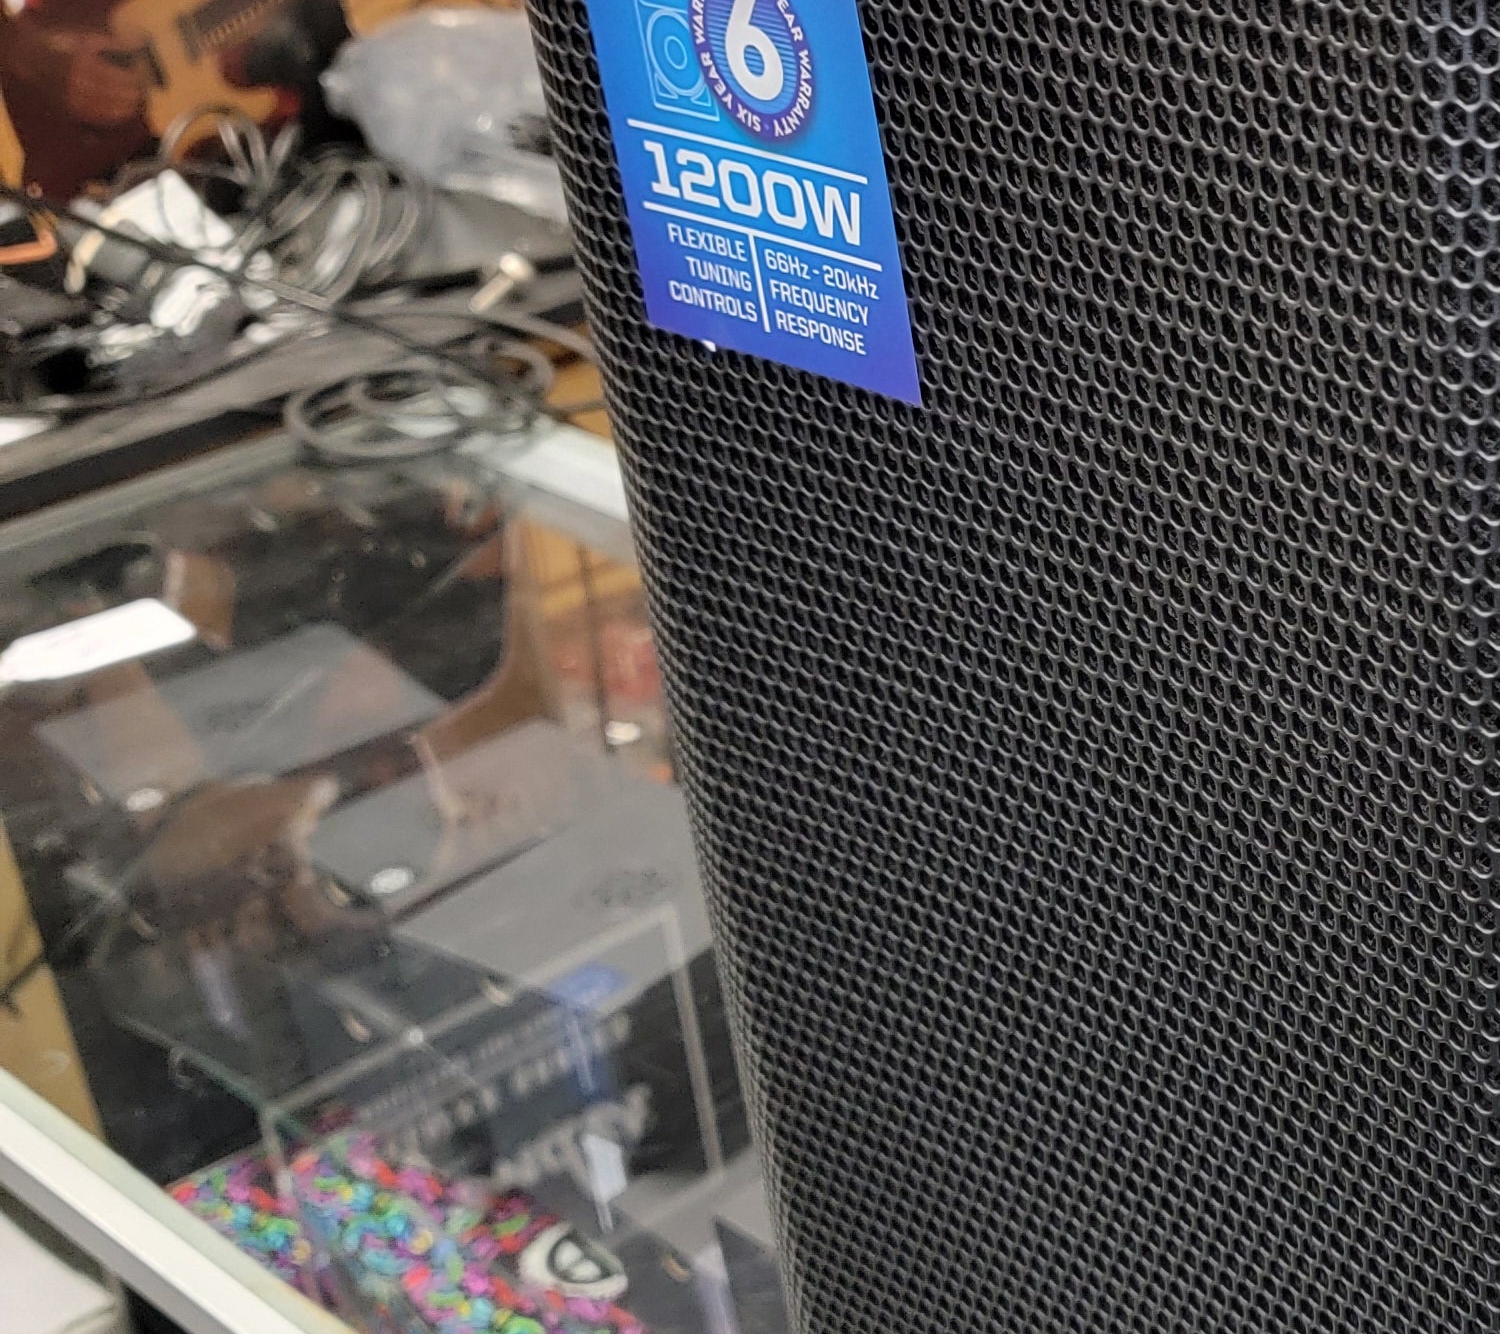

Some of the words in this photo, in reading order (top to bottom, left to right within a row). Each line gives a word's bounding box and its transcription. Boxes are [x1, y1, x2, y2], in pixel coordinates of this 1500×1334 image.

[701, 51, 733, 110] YEAR
[772, 49, 813, 138] WARRANTY
[735, 104, 762, 133] SIX
[643, 139, 861, 247] 1200W
[667, 222, 749, 263] FLEXIBLE
[685, 255, 753, 293] TUNING
[764, 247, 812, 281] 66Hz
[822, 264, 881, 301] 20kHz
[668, 279, 758, 324] CONTROLS
[769, 279, 869, 327] FREQUENCY
[774, 309, 867, 356] RESPONSE
